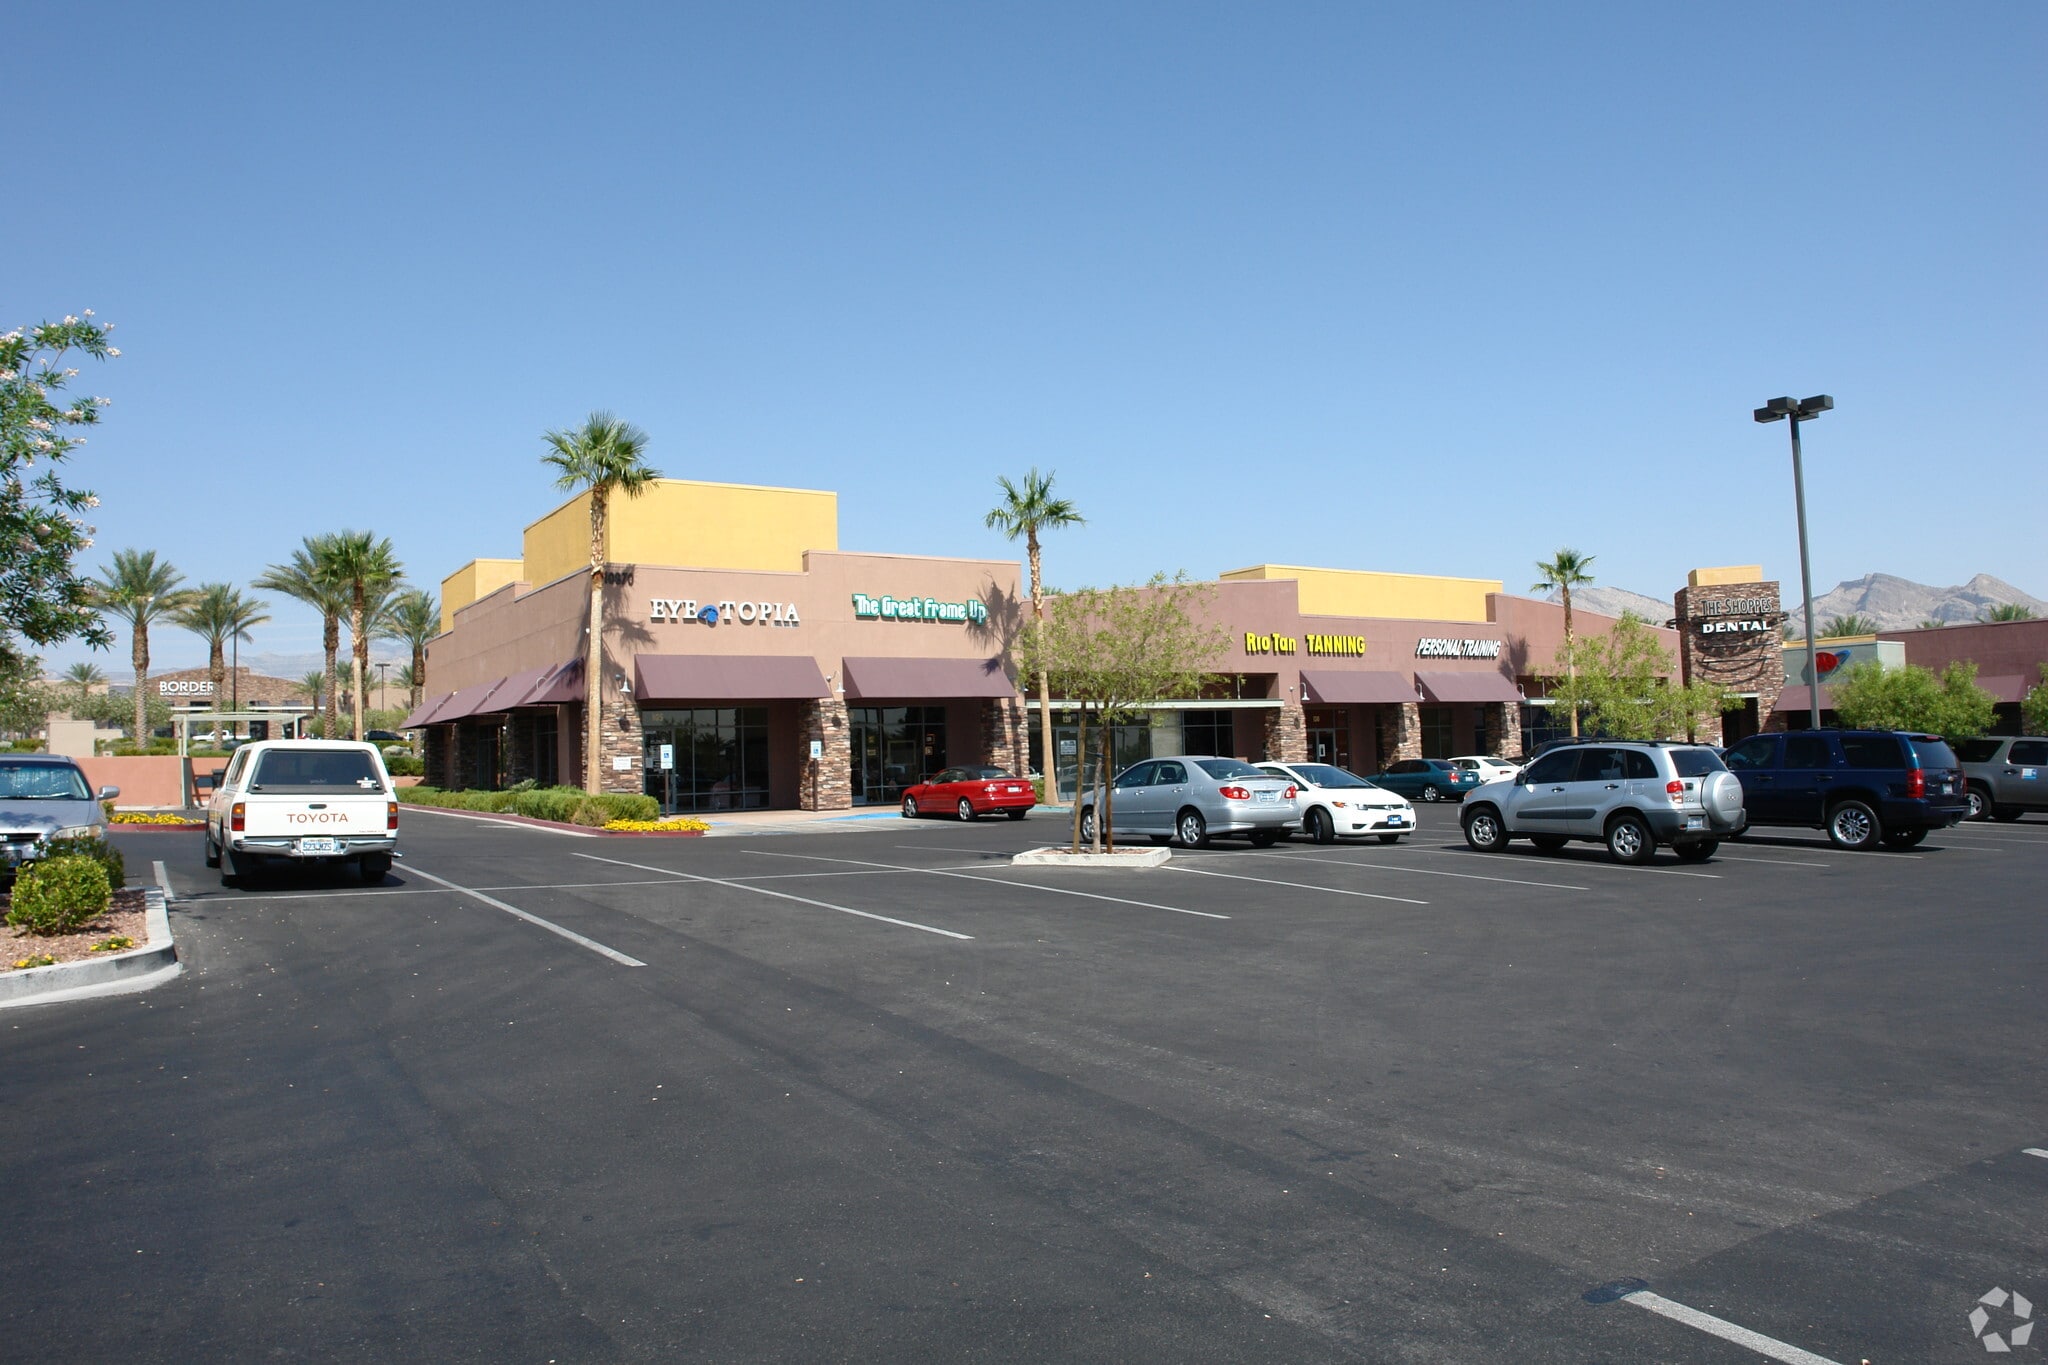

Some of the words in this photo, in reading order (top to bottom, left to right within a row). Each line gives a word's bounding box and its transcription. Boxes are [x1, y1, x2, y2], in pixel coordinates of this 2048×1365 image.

[650, 598, 698, 619] EYE
[719, 600, 801, 622] TOPIA
[852, 593, 880, 616] The
[880, 595, 922, 618] Great
[922, 598, 967, 620] Frame
[967, 600, 987, 626] Up
[1701, 600, 1721, 616] THE
[1724, 598, 1773, 615] SHOPPES
[1702, 621, 1772, 634] DENTAL
[1271, 632, 1297, 652] Tan
[1305, 634, 1367, 654] TANNING
[1416, 638, 1462, 656] PERSONAL
[1461, 639, 1501, 658] TRAINING
[286, 813, 349, 824] TOYOTA
